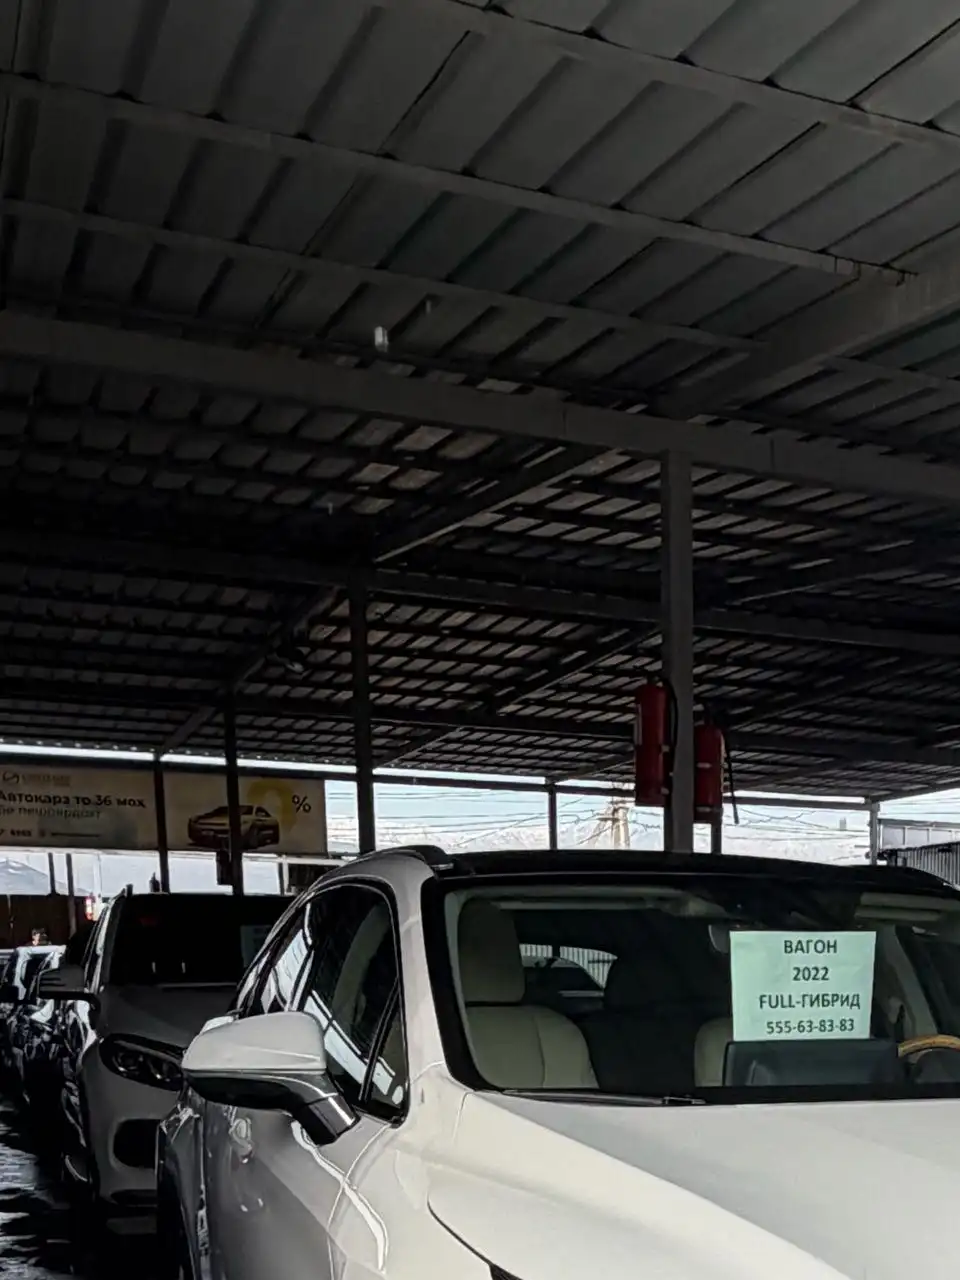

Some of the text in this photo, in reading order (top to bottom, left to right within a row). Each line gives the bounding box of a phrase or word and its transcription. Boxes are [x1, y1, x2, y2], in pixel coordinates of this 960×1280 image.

[95, 794, 112, 806] 36
[783, 939, 838, 954] ВАГОН
[792, 966, 830, 981] 2022
[758, 993, 861, 1010] FULL-ГИБРИД
[766, 1018, 855, 1035] 555-63-83-83
